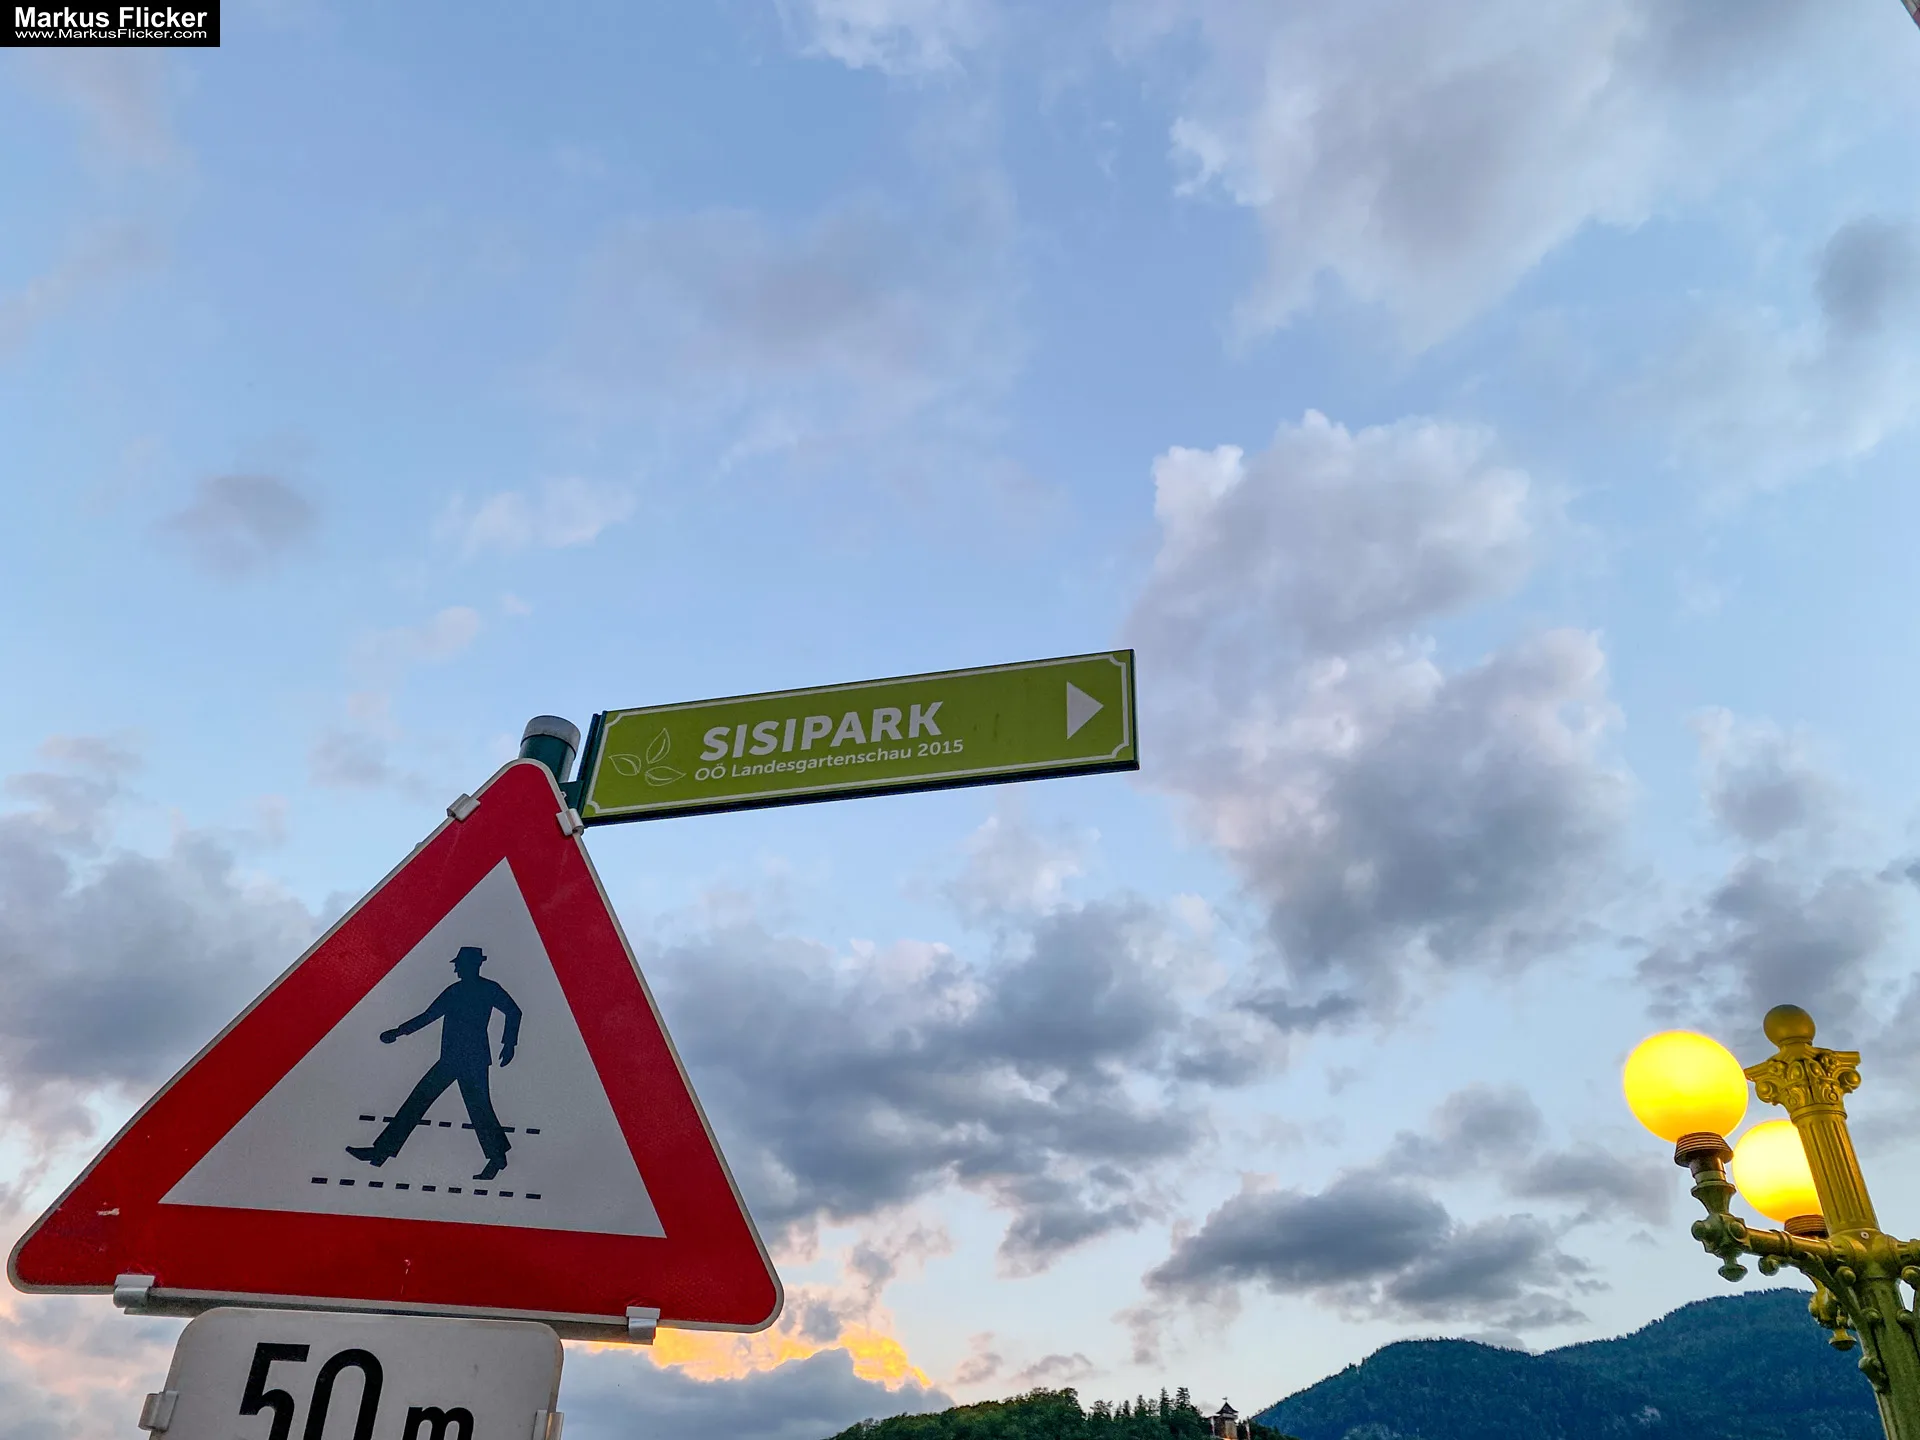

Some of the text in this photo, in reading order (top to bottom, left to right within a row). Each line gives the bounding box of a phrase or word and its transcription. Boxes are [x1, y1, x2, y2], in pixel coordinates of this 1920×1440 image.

[694, 739, 964, 781] OÖ Landesgartenschau 2015
[699, 700, 944, 761] SISIPARK
[239, 1342, 384, 1440] 50
